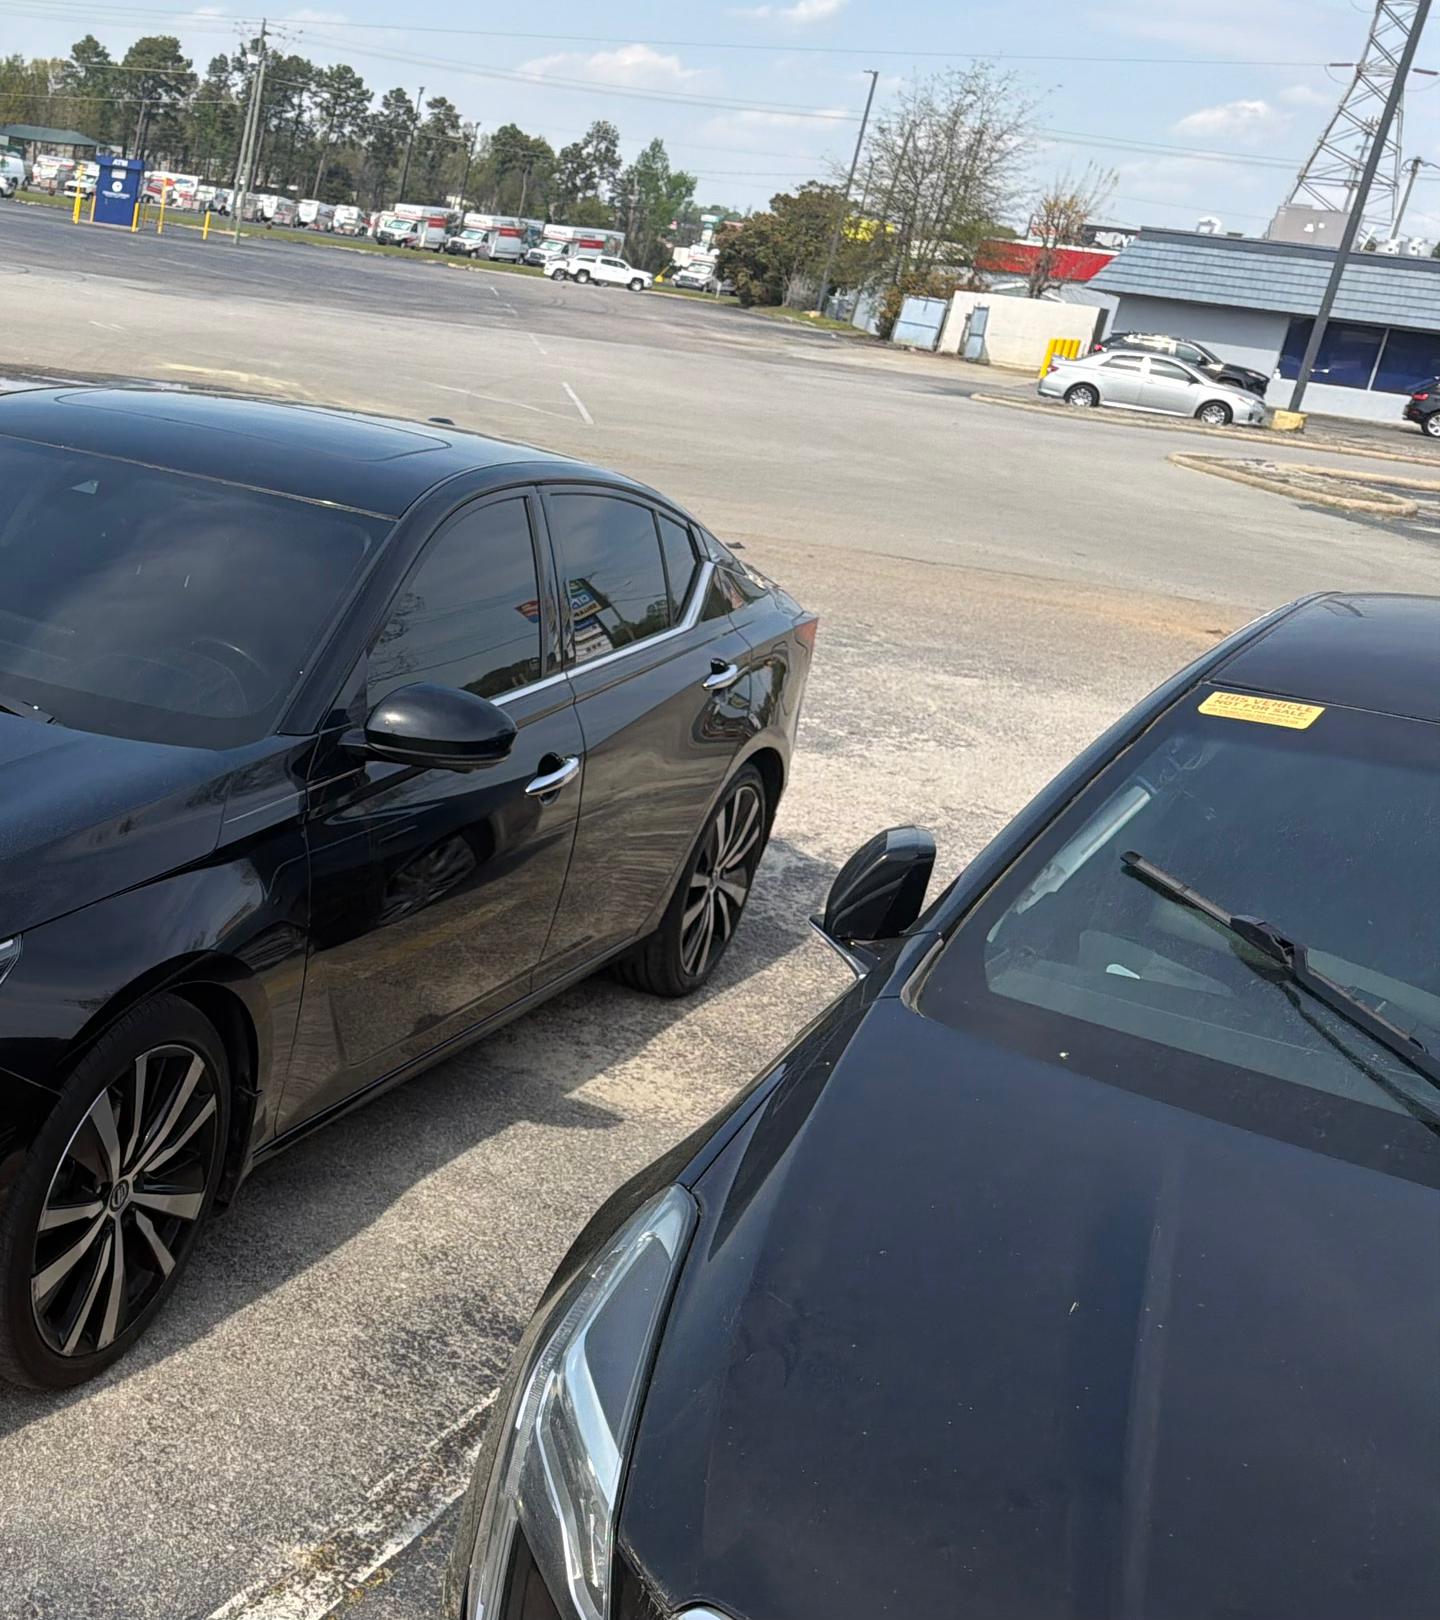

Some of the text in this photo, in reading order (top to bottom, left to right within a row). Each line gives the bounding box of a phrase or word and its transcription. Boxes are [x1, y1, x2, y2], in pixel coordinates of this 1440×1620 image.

[1218, 694, 1249, 703] THIS
[1254, 698, 1314, 713] VEHICLE
[1242, 703, 1269, 712] FOR
[1273, 708, 1308, 716] SALE
